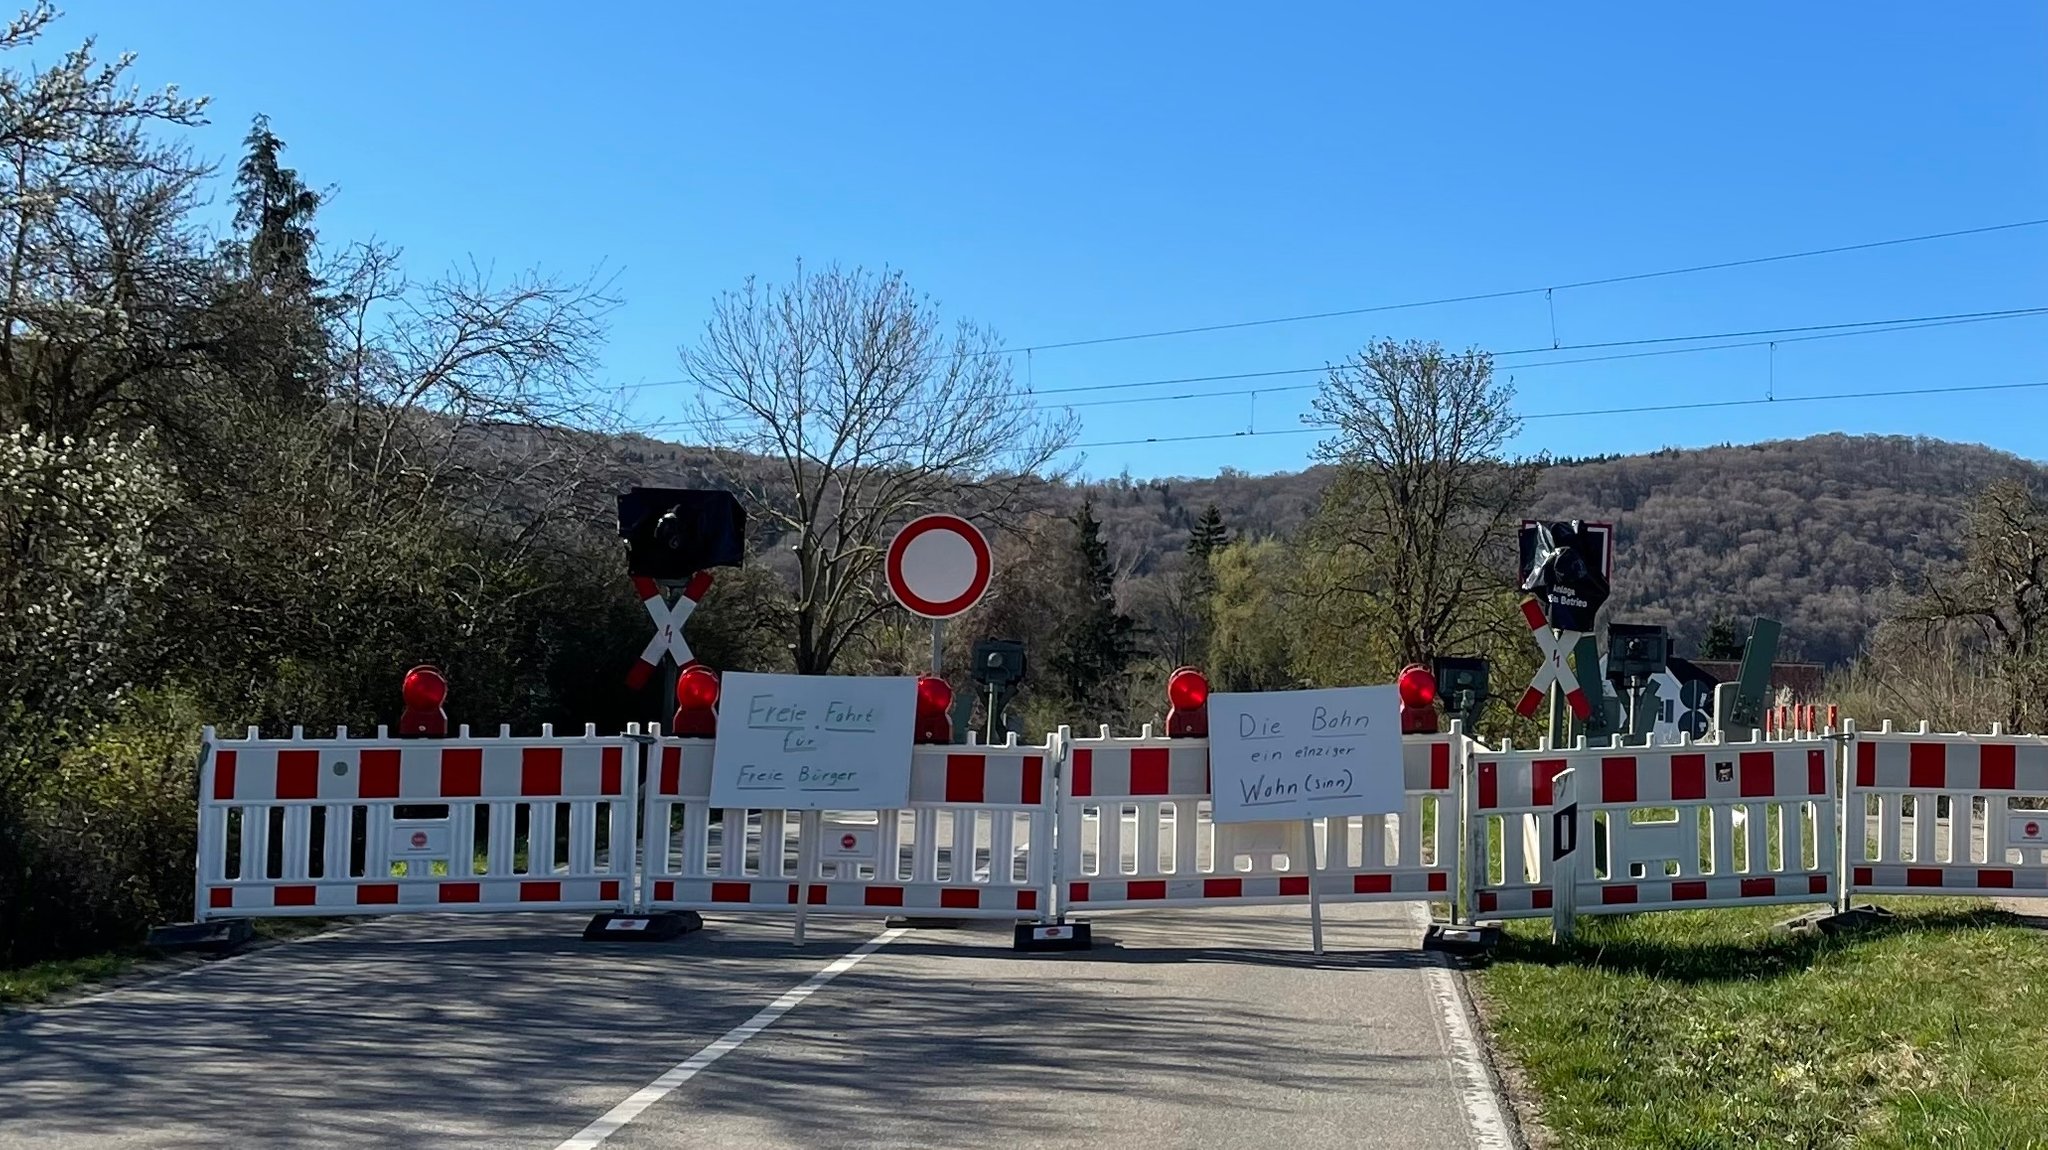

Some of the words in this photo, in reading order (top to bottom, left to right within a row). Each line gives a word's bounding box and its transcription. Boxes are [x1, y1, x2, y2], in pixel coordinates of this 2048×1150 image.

[748, 694, 807, 725] Freie
[825, 701, 873, 722] Fahrt
[1240, 713, 1281, 737] Die
[1312, 706, 1370, 731] Bahn
[1251, 750, 1283, 763] ein
[1295, 746, 1356, 758] einziger
[737, 765, 784, 787] Freie
[798, 765, 858, 786] Bürger
